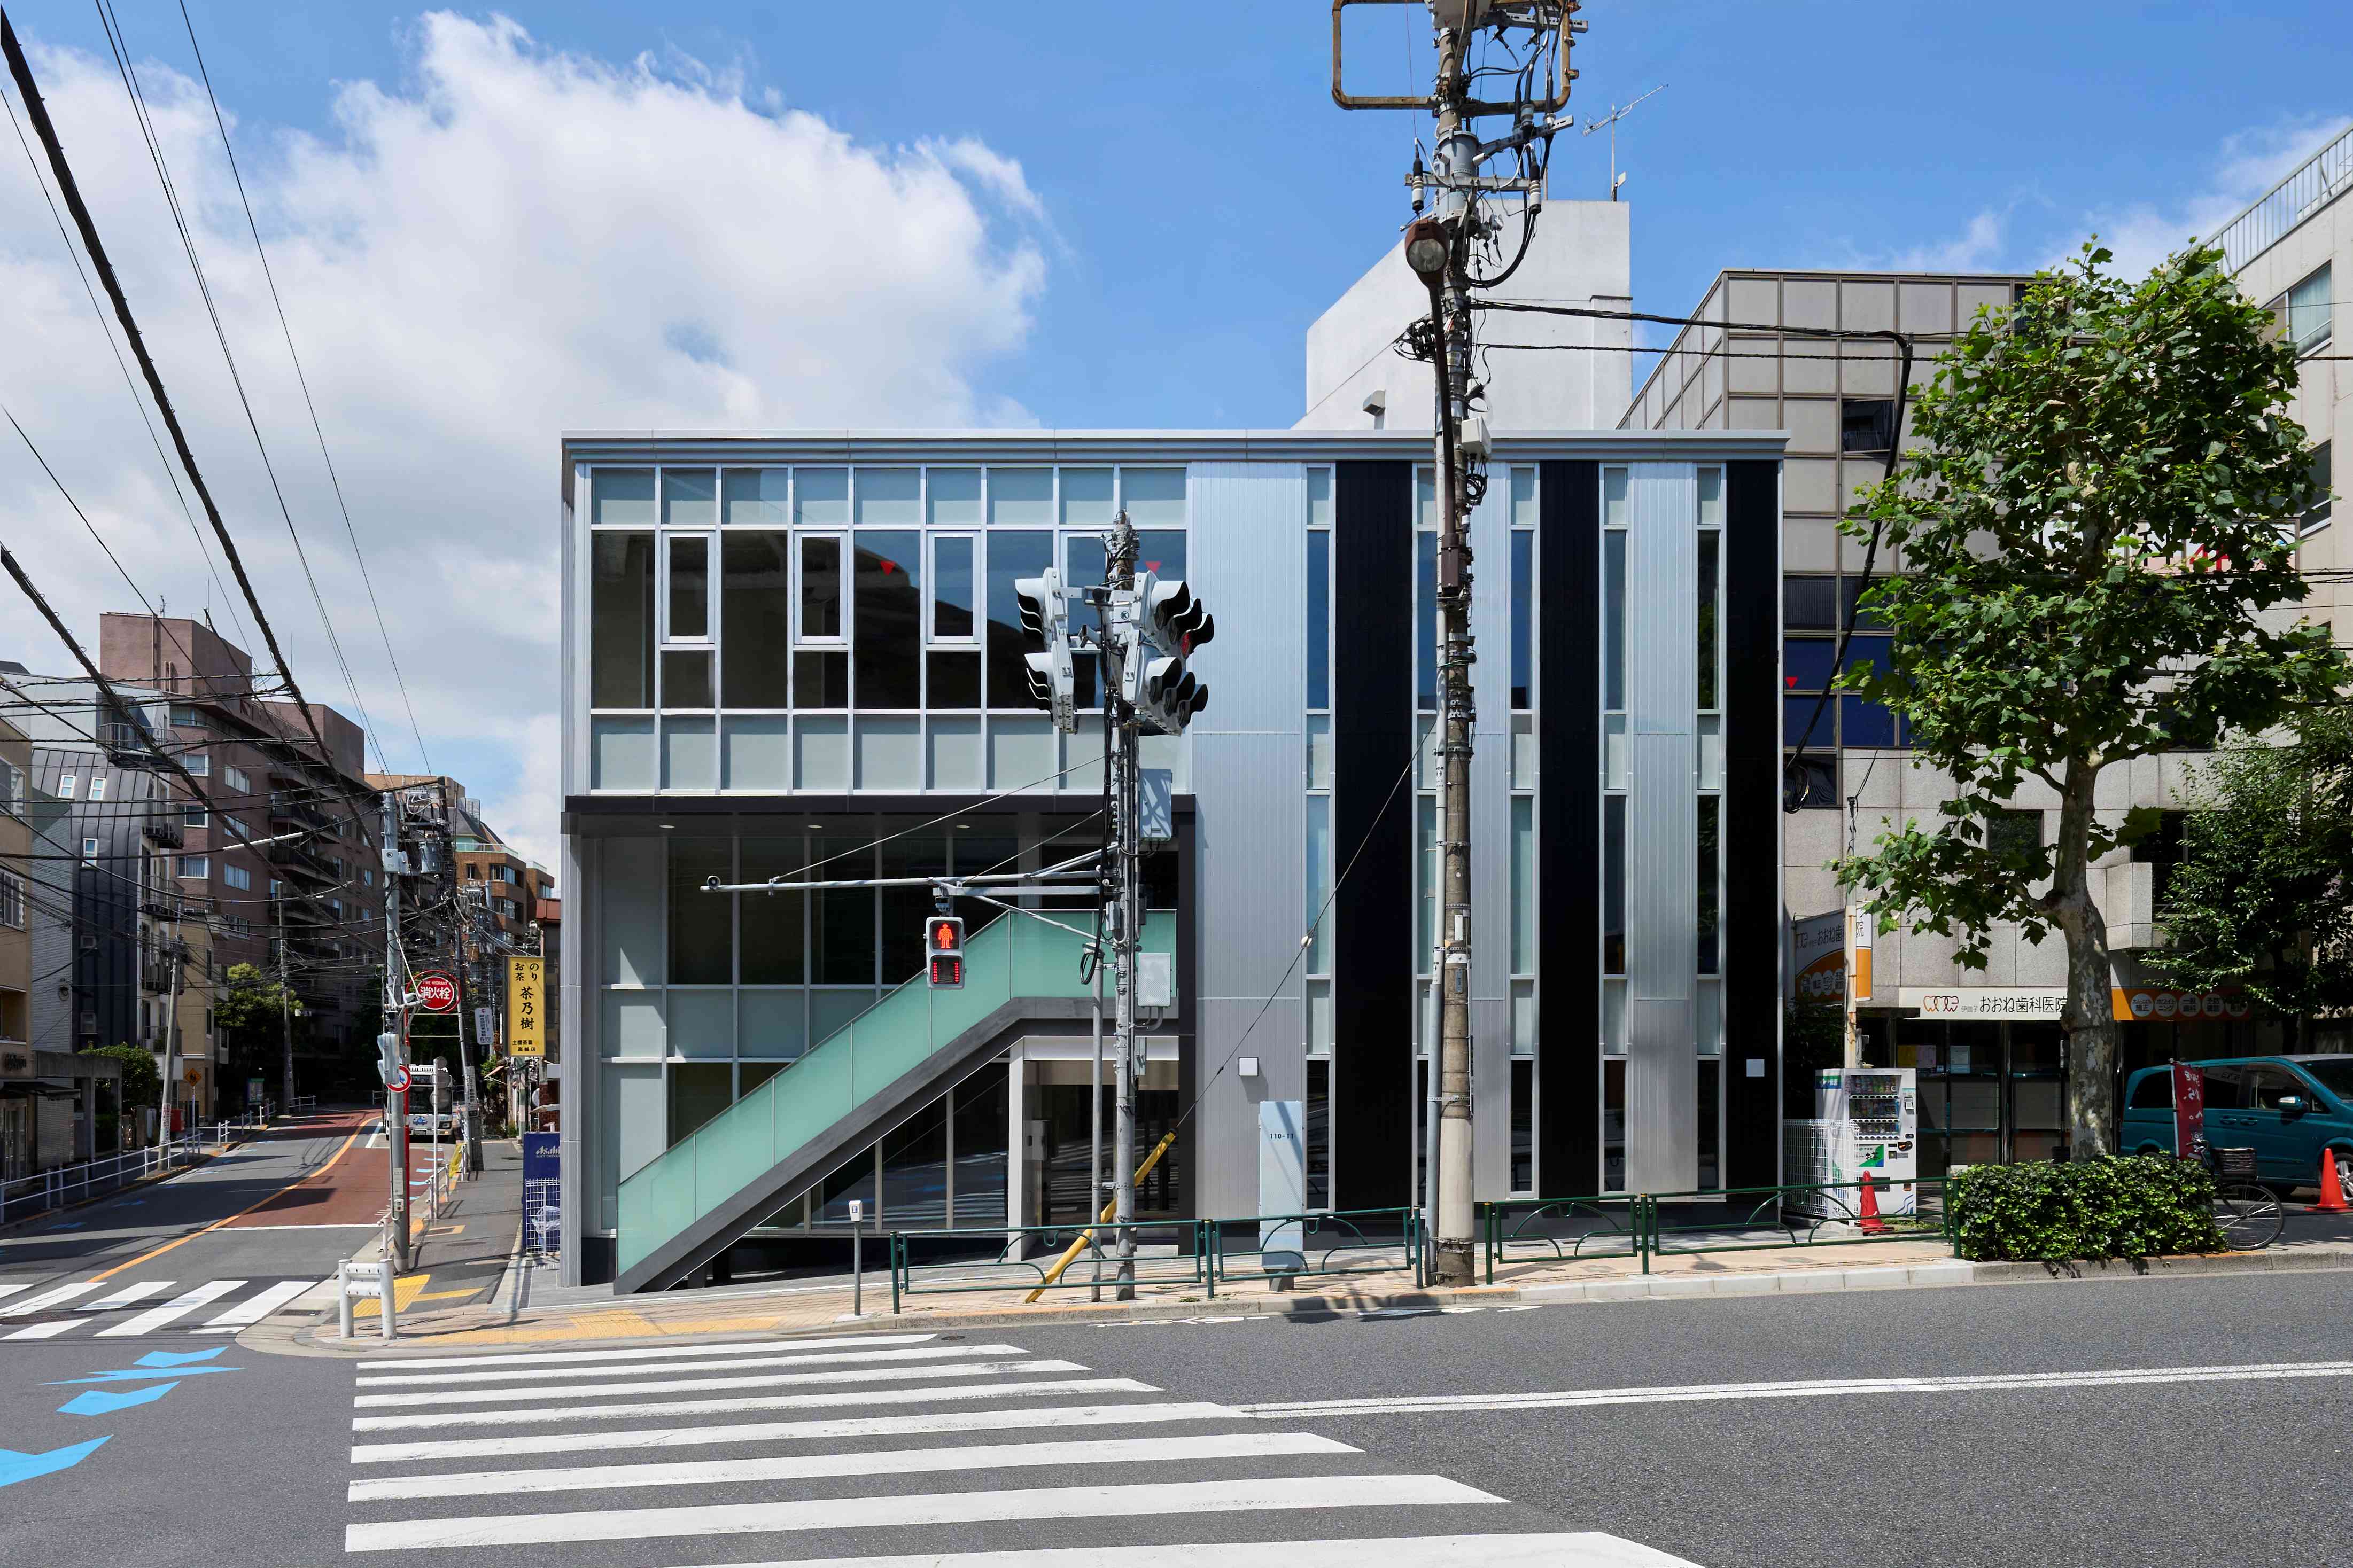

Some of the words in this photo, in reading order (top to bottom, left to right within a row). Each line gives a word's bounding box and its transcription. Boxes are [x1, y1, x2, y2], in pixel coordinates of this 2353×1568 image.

[515, 963, 525, 981] お茶
[530, 963, 539, 981] のり
[420, 986, 451, 1000] 消火栓
[519, 986, 534, 1030] 茶乃樹
